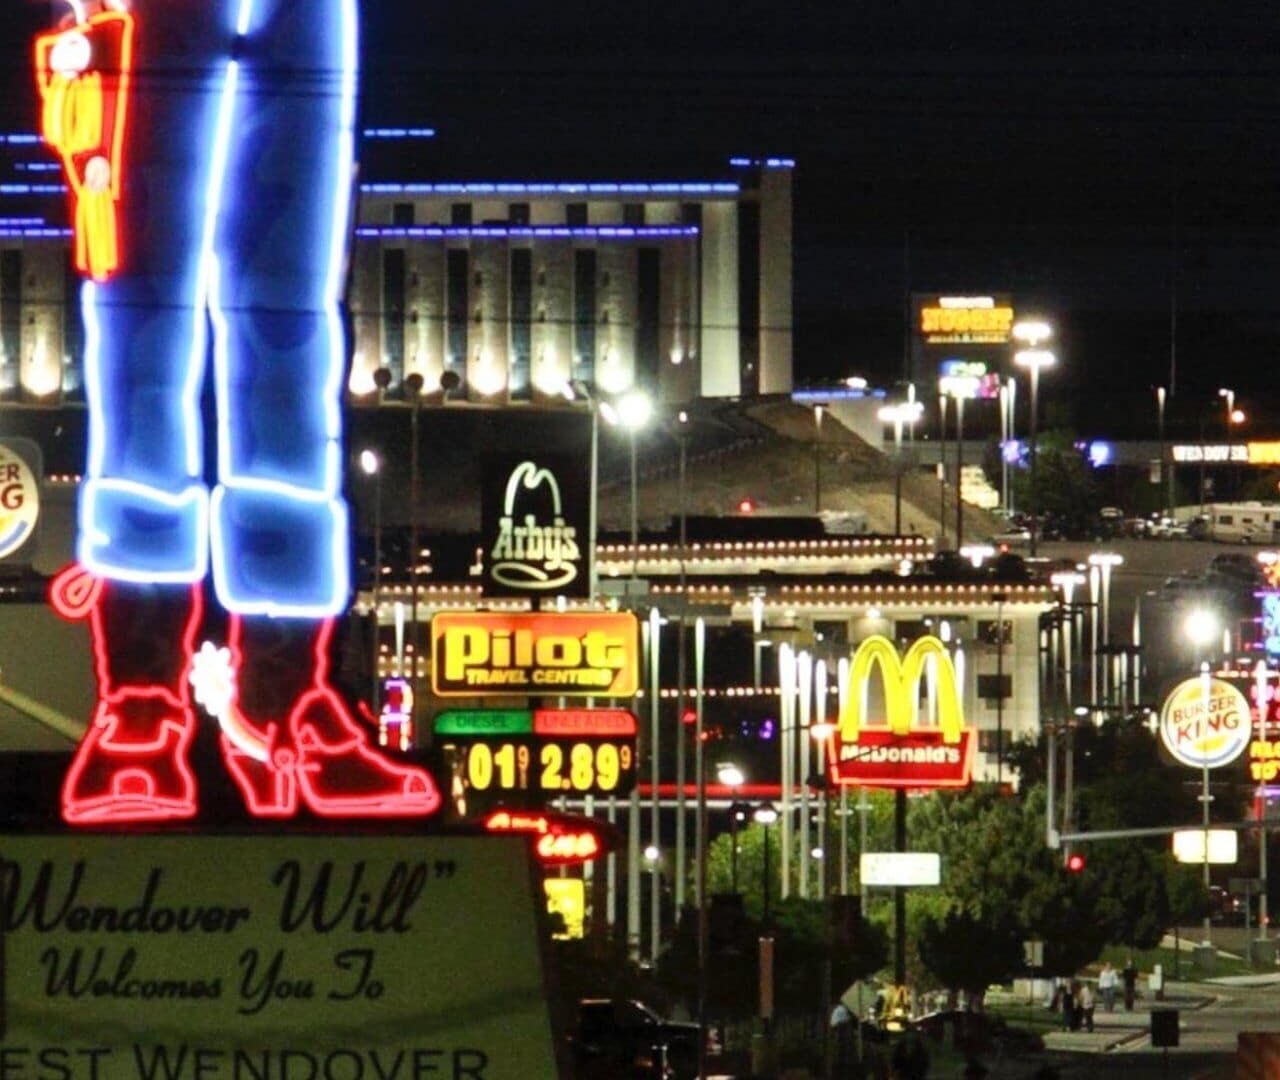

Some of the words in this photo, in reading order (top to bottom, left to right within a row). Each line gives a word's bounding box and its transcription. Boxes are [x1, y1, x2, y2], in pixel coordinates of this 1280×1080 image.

[491, 514, 580, 571] Arby's
[445, 626, 627, 680] Pilot
[466, 669, 528, 685] TRAVEL
[532, 669, 613, 686] CENTERS
[455, 715, 507, 730] DIESEL
[1173, 695, 1237, 724] BURGER
[1176, 712, 1240, 744] KING
[840, 745, 960, 764] McDonald's
[3, 858, 249, 933] Wendover
[39, 946, 222, 999] Welcomes
[237, 947, 314, 1015] You
[327, 948, 385, 1000] To
[133, 1041, 490, 1080] WENDOVER
